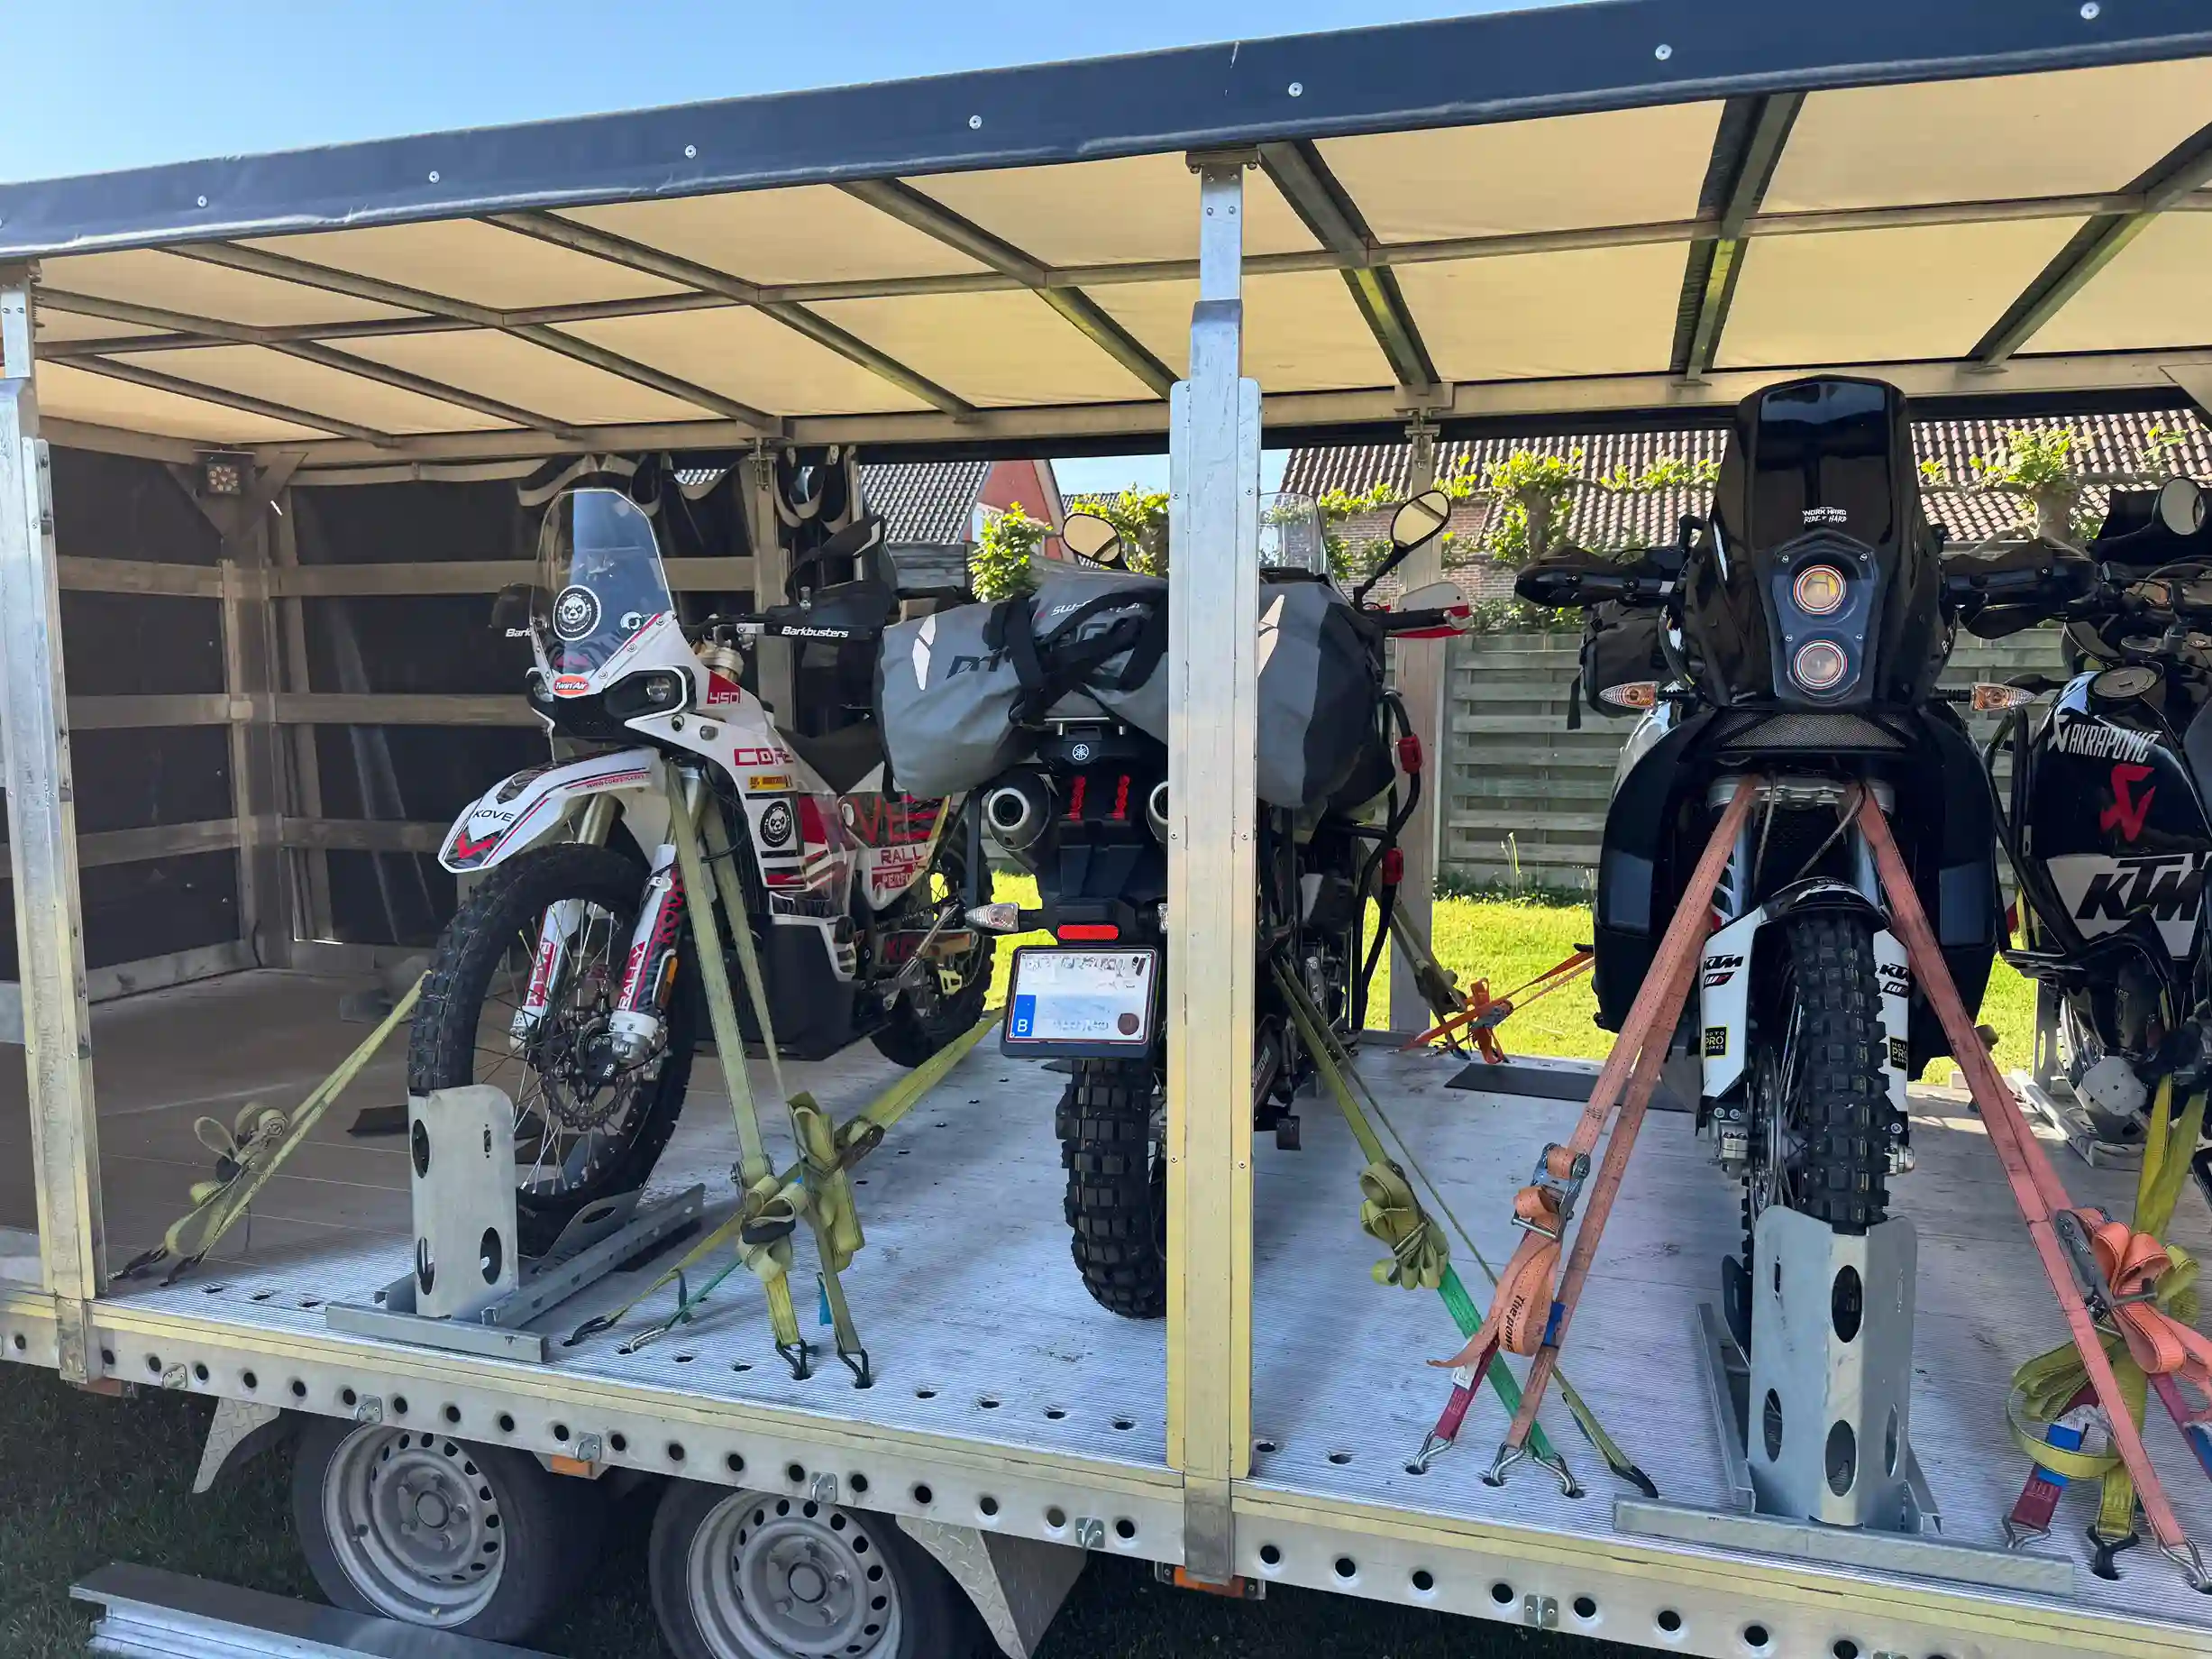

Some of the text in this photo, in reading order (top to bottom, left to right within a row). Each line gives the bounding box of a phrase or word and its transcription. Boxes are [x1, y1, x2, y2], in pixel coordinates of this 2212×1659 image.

[1828, 515, 1847, 523] HARD
[781, 626, 849, 638] Barkbusters
[709, 692, 740, 704] 450
[472, 809, 515, 822] KOVE
[2075, 856, 2202, 921] KTM
[1703, 954, 1744, 973] KTM
[618, 946, 645, 1012] RALLY
[1017, 1019, 1028, 1032] B
